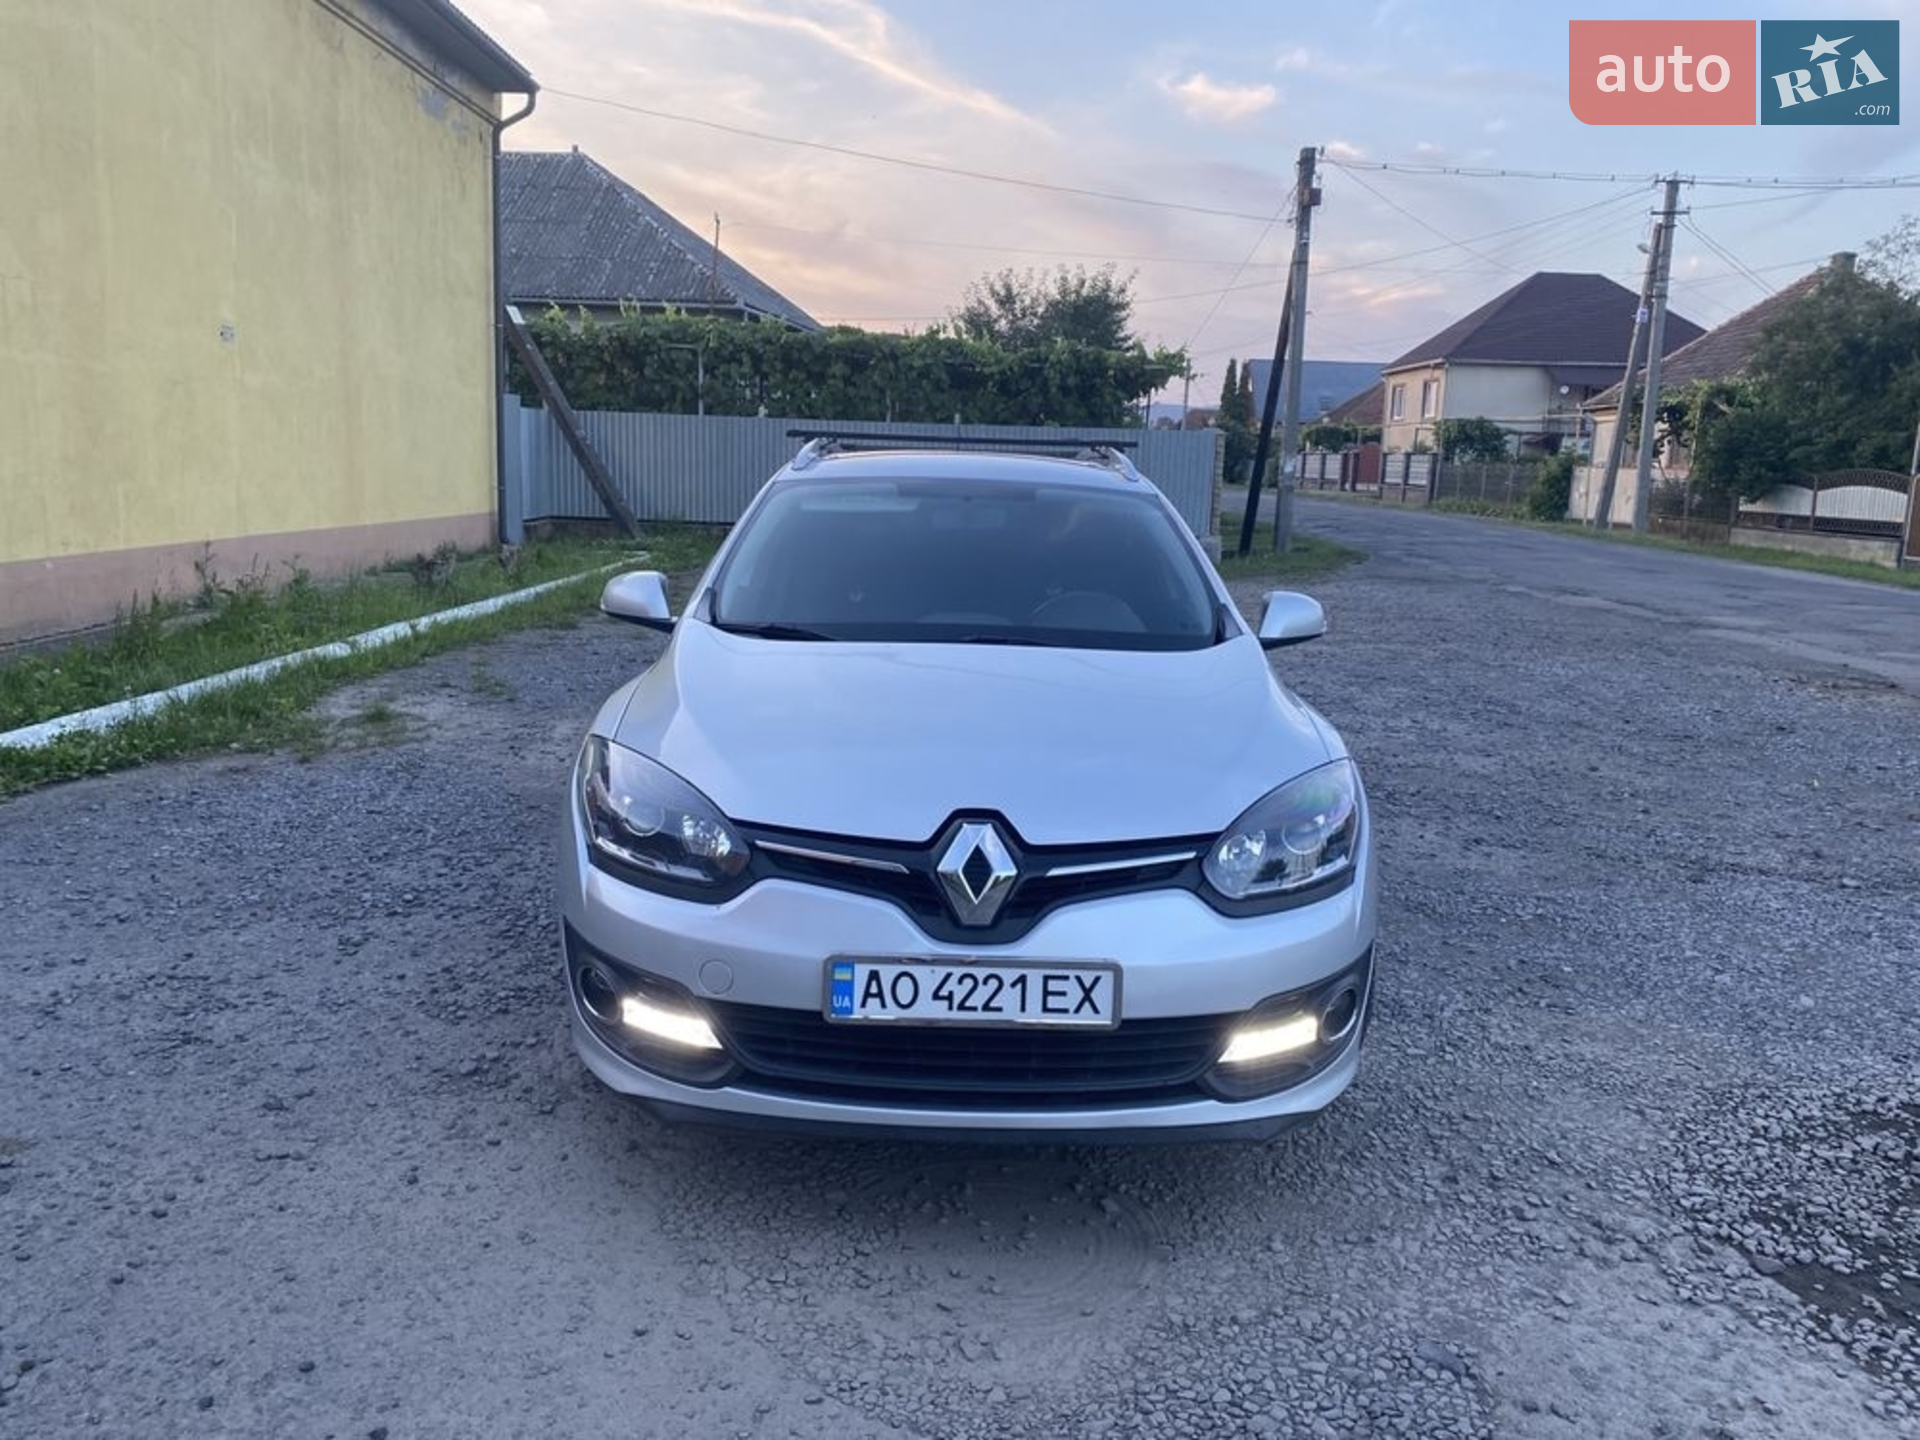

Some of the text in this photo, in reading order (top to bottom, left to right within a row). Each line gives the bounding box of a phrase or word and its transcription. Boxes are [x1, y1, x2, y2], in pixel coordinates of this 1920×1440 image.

[832, 994, 851, 1009] UA
[860, 969, 1103, 1014] AO 4221 EX
